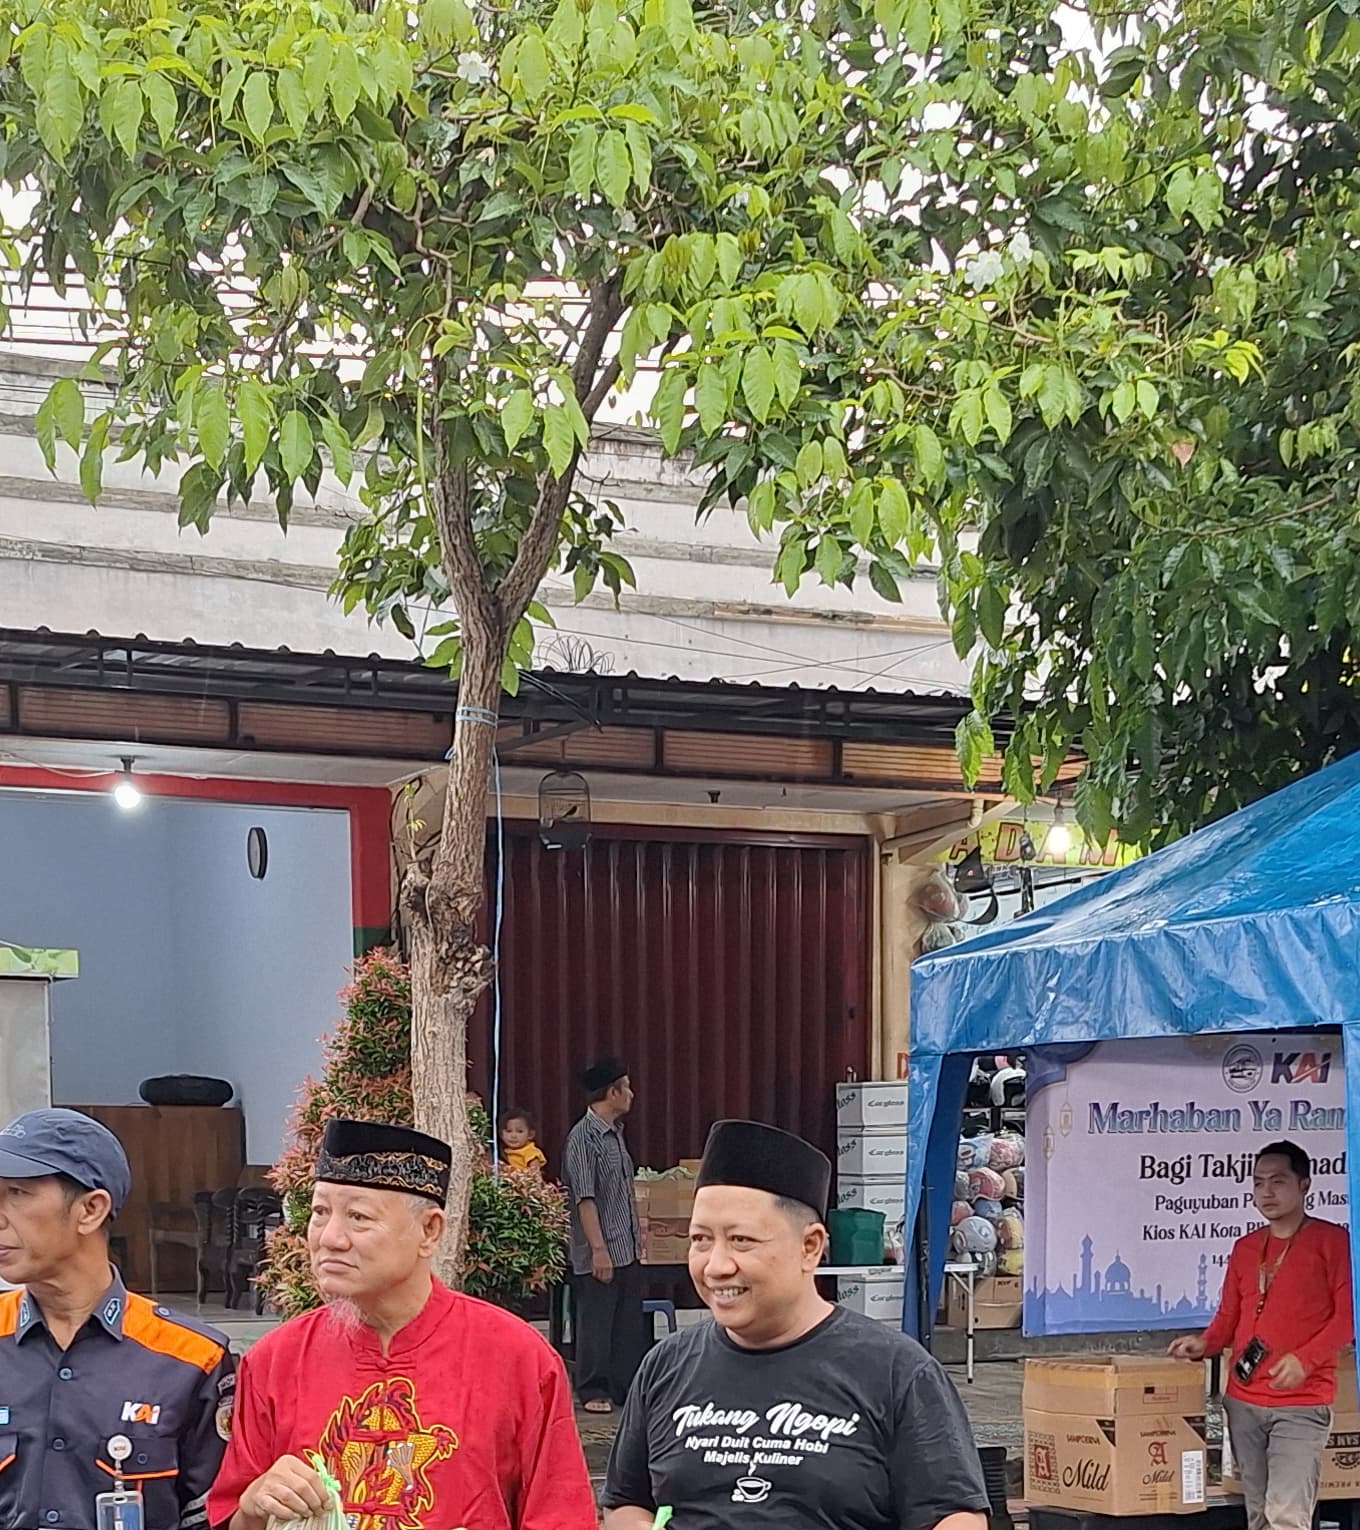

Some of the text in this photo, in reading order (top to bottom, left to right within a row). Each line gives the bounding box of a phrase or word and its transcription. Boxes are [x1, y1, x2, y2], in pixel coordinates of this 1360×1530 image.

[1271, 1052, 1331, 1084] KAI
[1088, 1100, 1242, 1134] Marhaban
[1248, 1101, 1282, 1132] Ya
[1140, 1154, 1192, 1185] Bagi
[1155, 1192, 1239, 1214] Paguyuban
[1143, 1225, 1175, 1240] Kios
[1180, 1224, 1206, 1239] KAI
[1210, 1223, 1241, 1238] Kota
[121, 1401, 161, 1425] KAI
[673, 1402, 860, 1440] Tukang Ngopi
[685, 1436, 829, 1454] Nyari Duit Cuma Hobi
[703, 1451, 803, 1466] Majelis Kuliner
[1062, 1459, 1111, 1492] Mild
[1142, 1469, 1176, 1485] Mild
